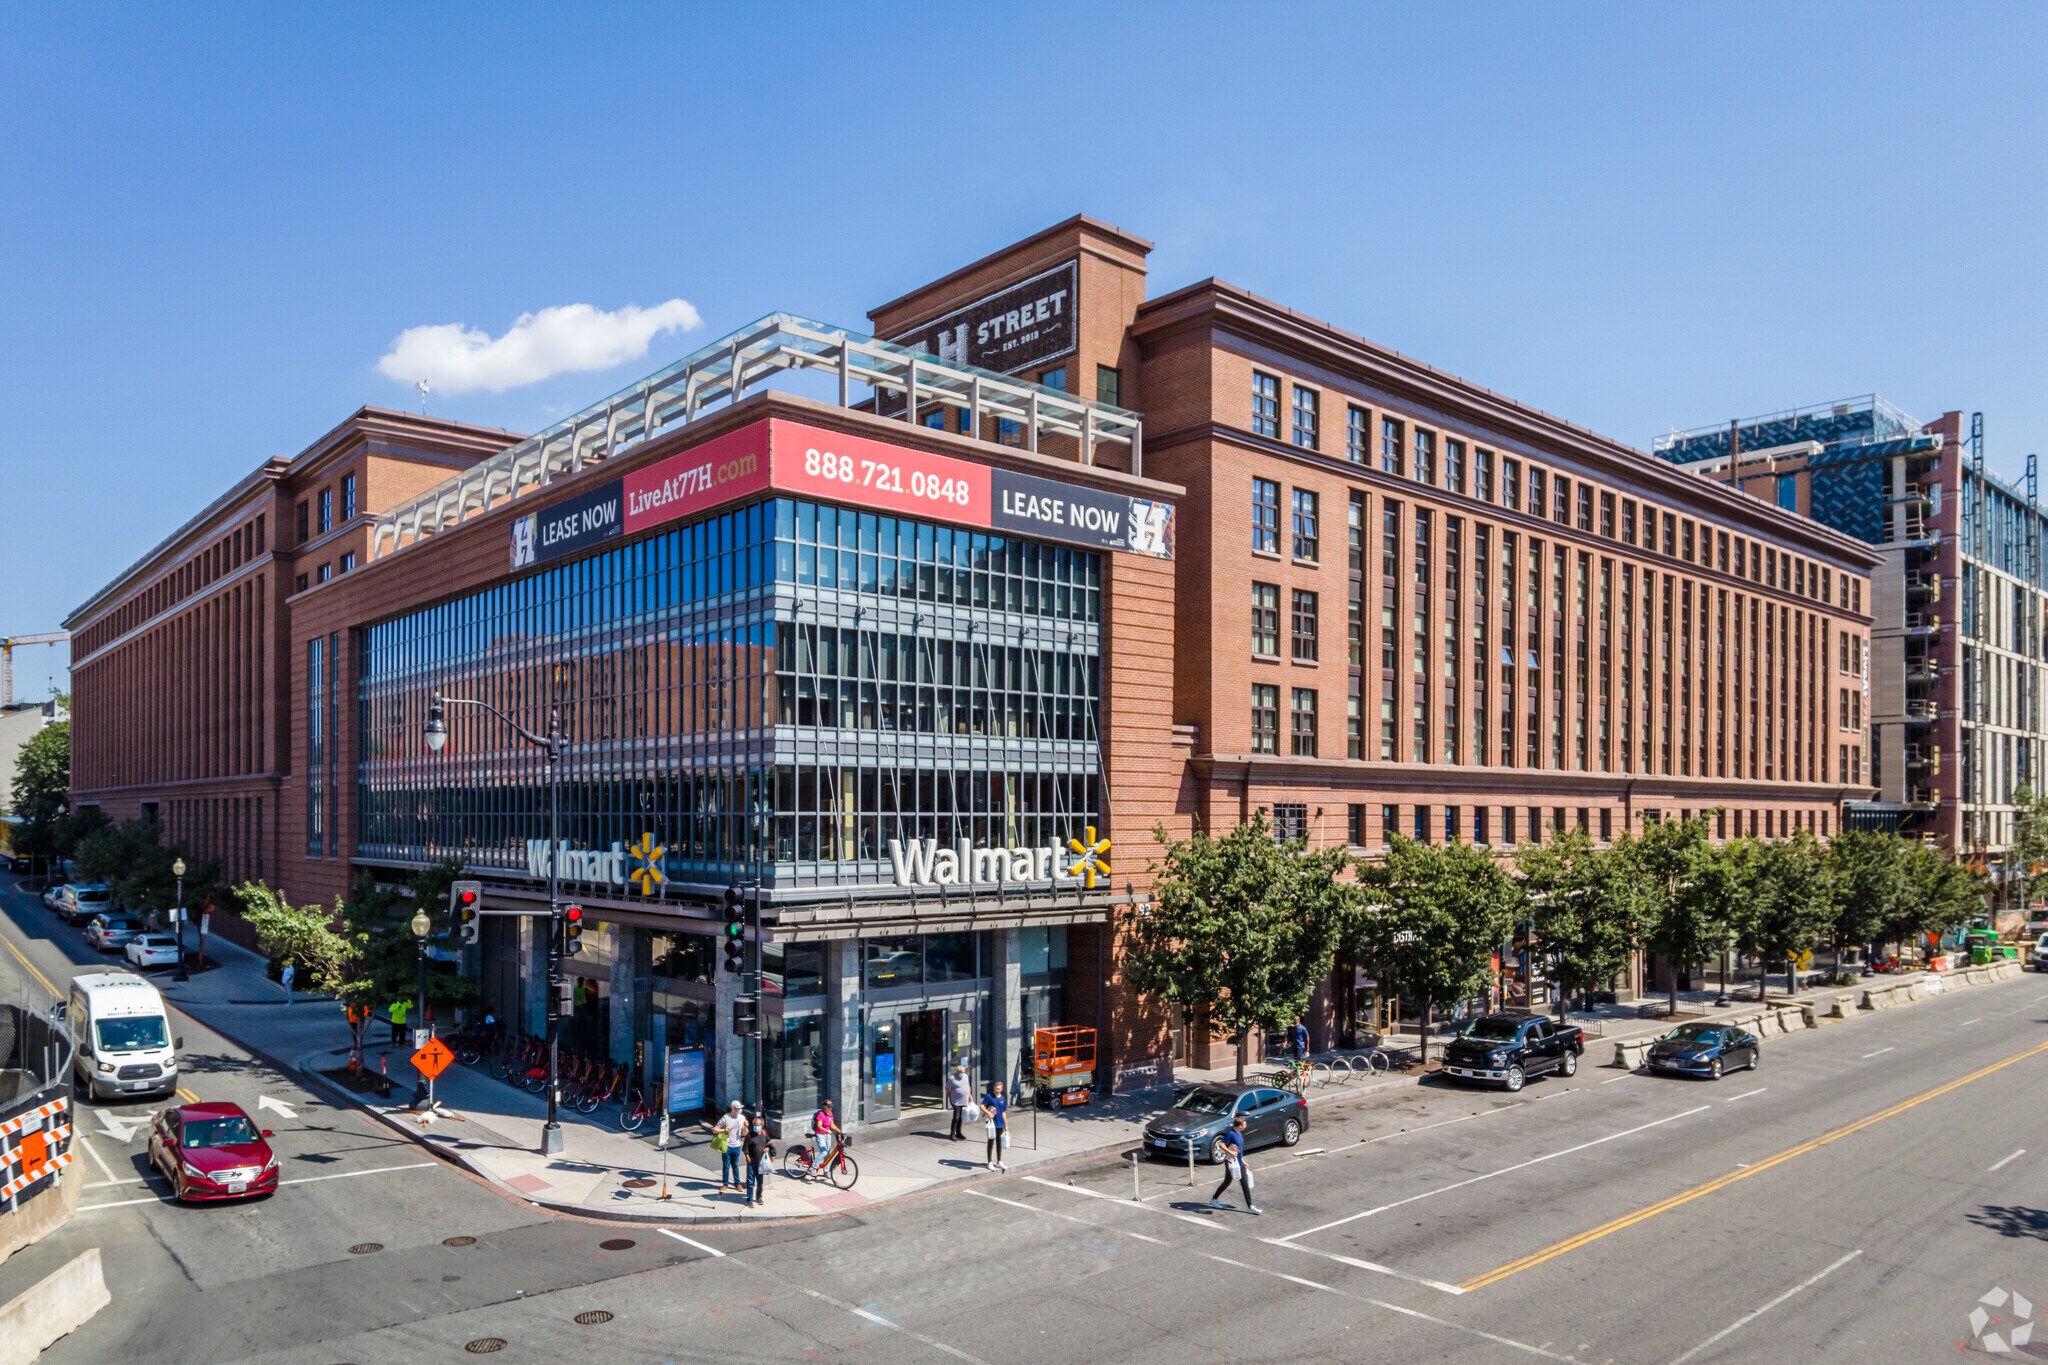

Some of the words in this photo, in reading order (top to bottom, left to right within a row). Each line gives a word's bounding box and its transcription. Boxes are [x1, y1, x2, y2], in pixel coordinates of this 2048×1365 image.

[977, 289, 1067, 345] STREET
[1003, 339, 1019, 351] EST.
[629, 452, 757, 516] LiveAt77H.com
[805, 448, 969, 505] 888.721.0848
[543, 513, 579, 546] LEASE
[582, 499, 617, 532] NOW
[1003, 489, 1064, 524] LEASE
[1070, 503, 1120, 534] NOW
[527, 839, 624, 884] Walmart
[888, 836, 1066, 887] Walmart
